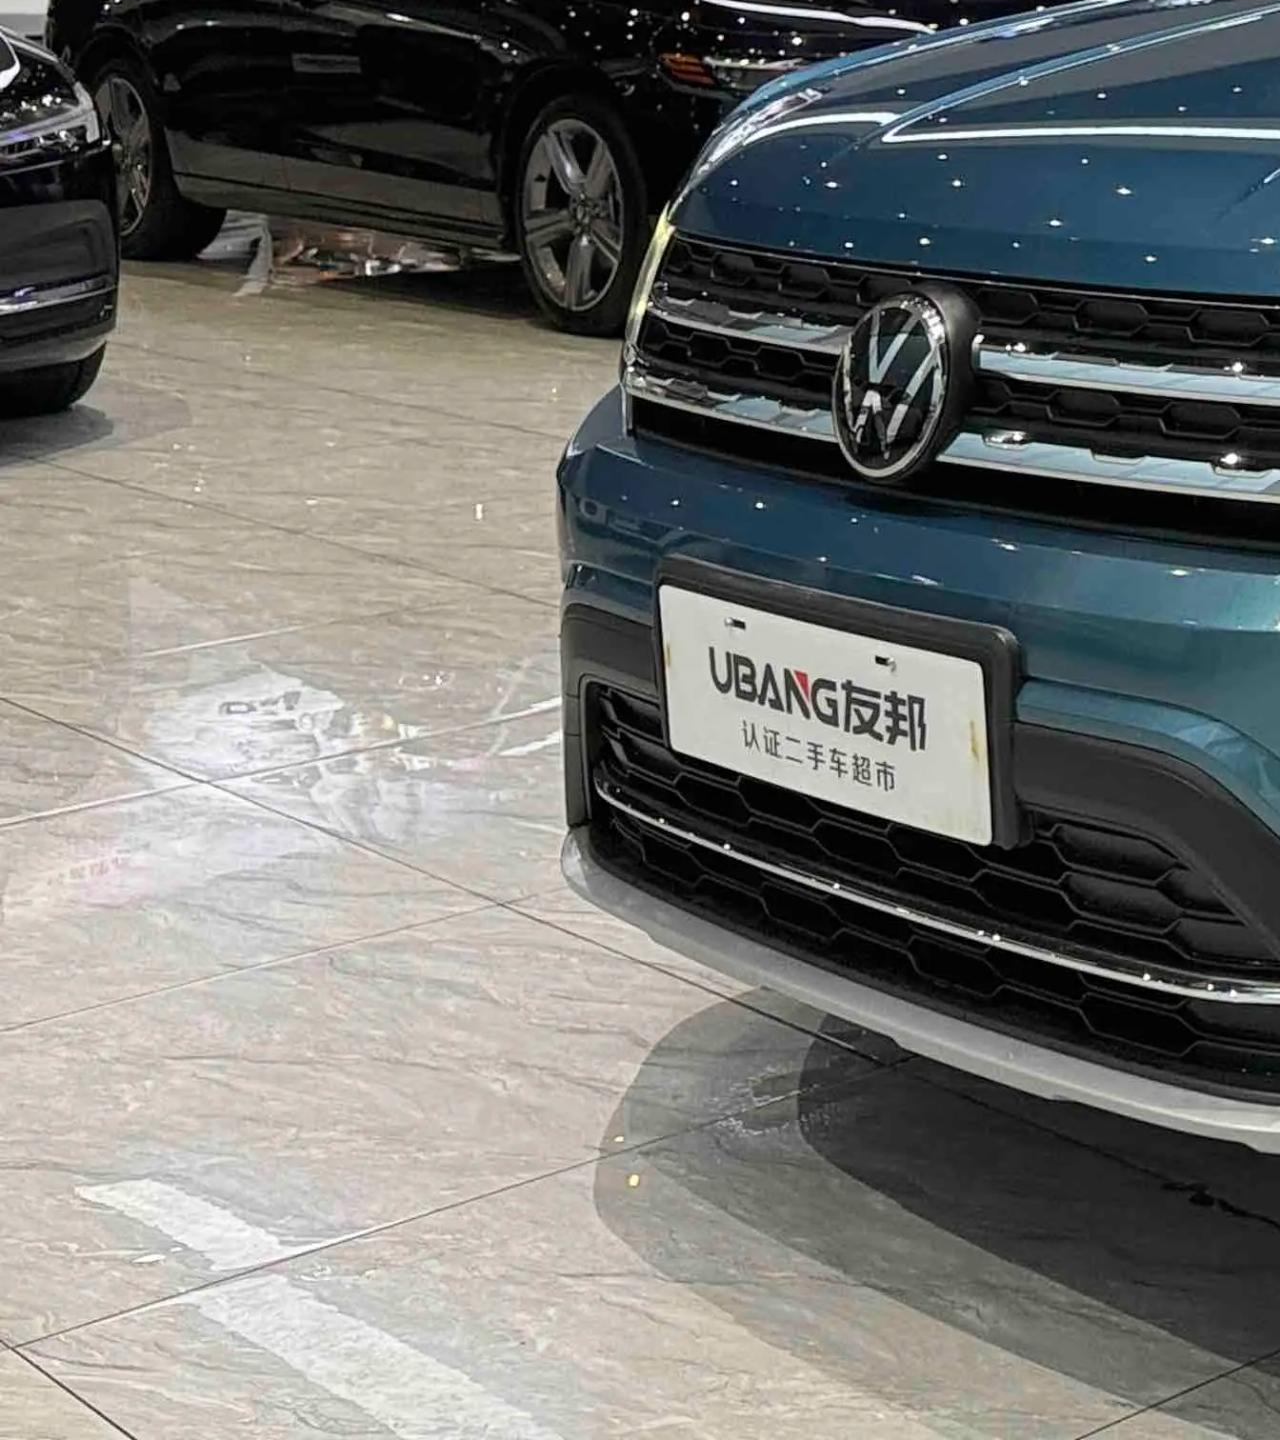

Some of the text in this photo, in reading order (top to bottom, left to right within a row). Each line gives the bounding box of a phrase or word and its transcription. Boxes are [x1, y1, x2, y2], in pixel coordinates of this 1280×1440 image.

[708, 645, 928, 752] UBANG友邦
[741, 718, 898, 793] 认证二手车超市
